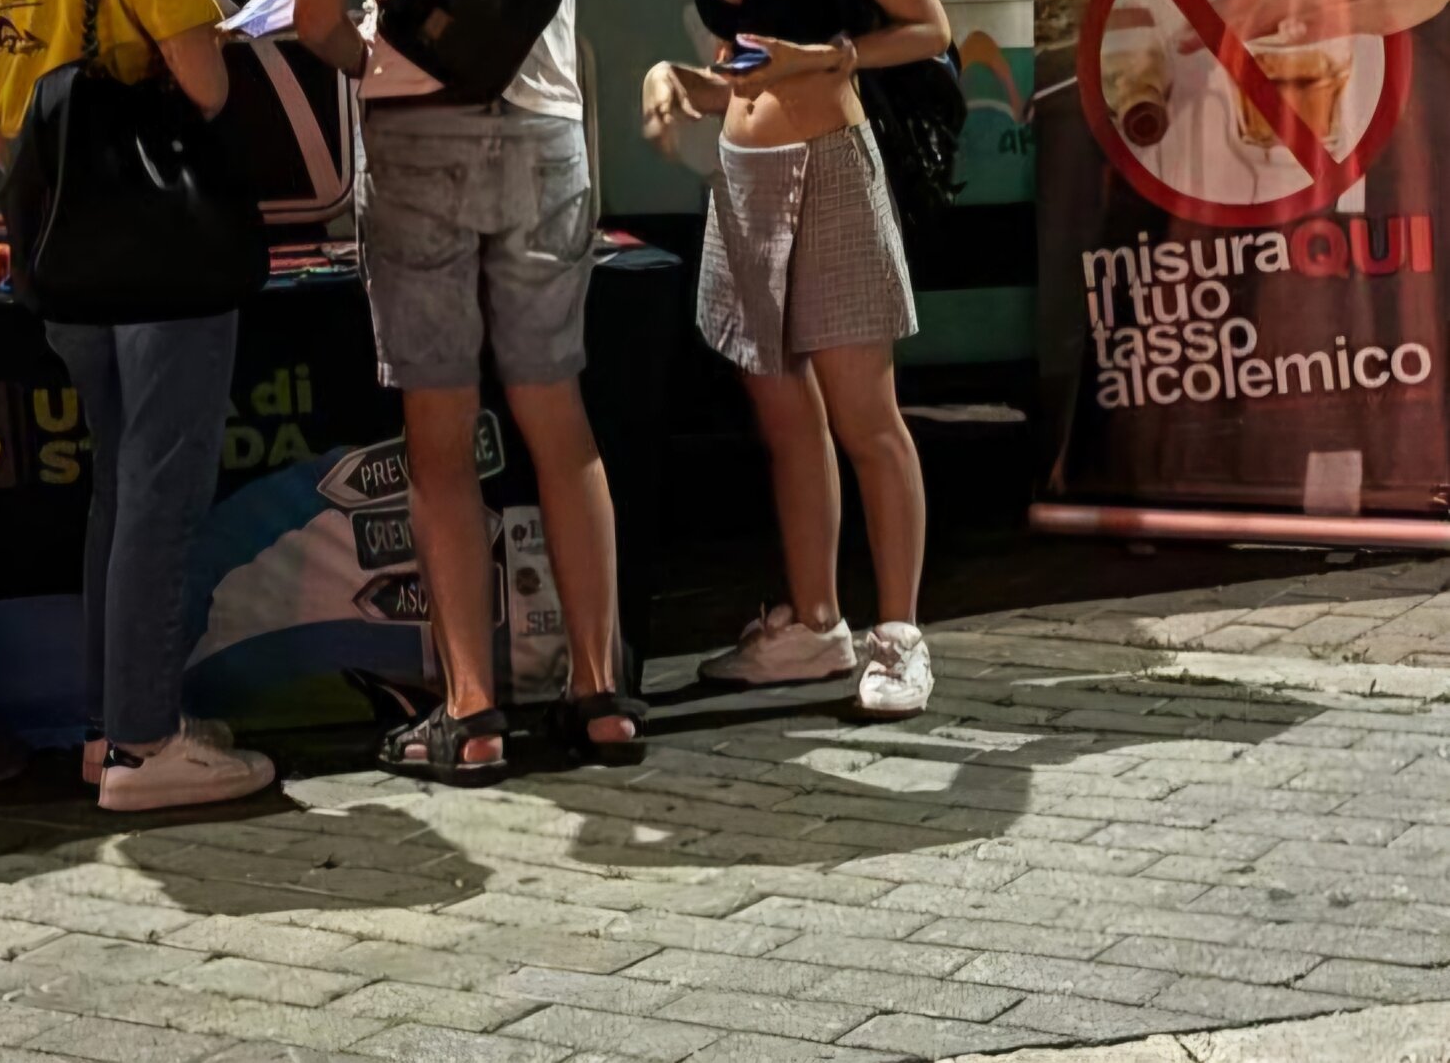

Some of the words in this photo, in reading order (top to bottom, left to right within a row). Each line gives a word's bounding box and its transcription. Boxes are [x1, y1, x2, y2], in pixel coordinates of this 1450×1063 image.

[1129, 273, 1230, 326] tuo
[1091, 317, 1258, 369] tasso
[251, 363, 314, 416] di
[1096, 335, 1432, 410] alcolemico
